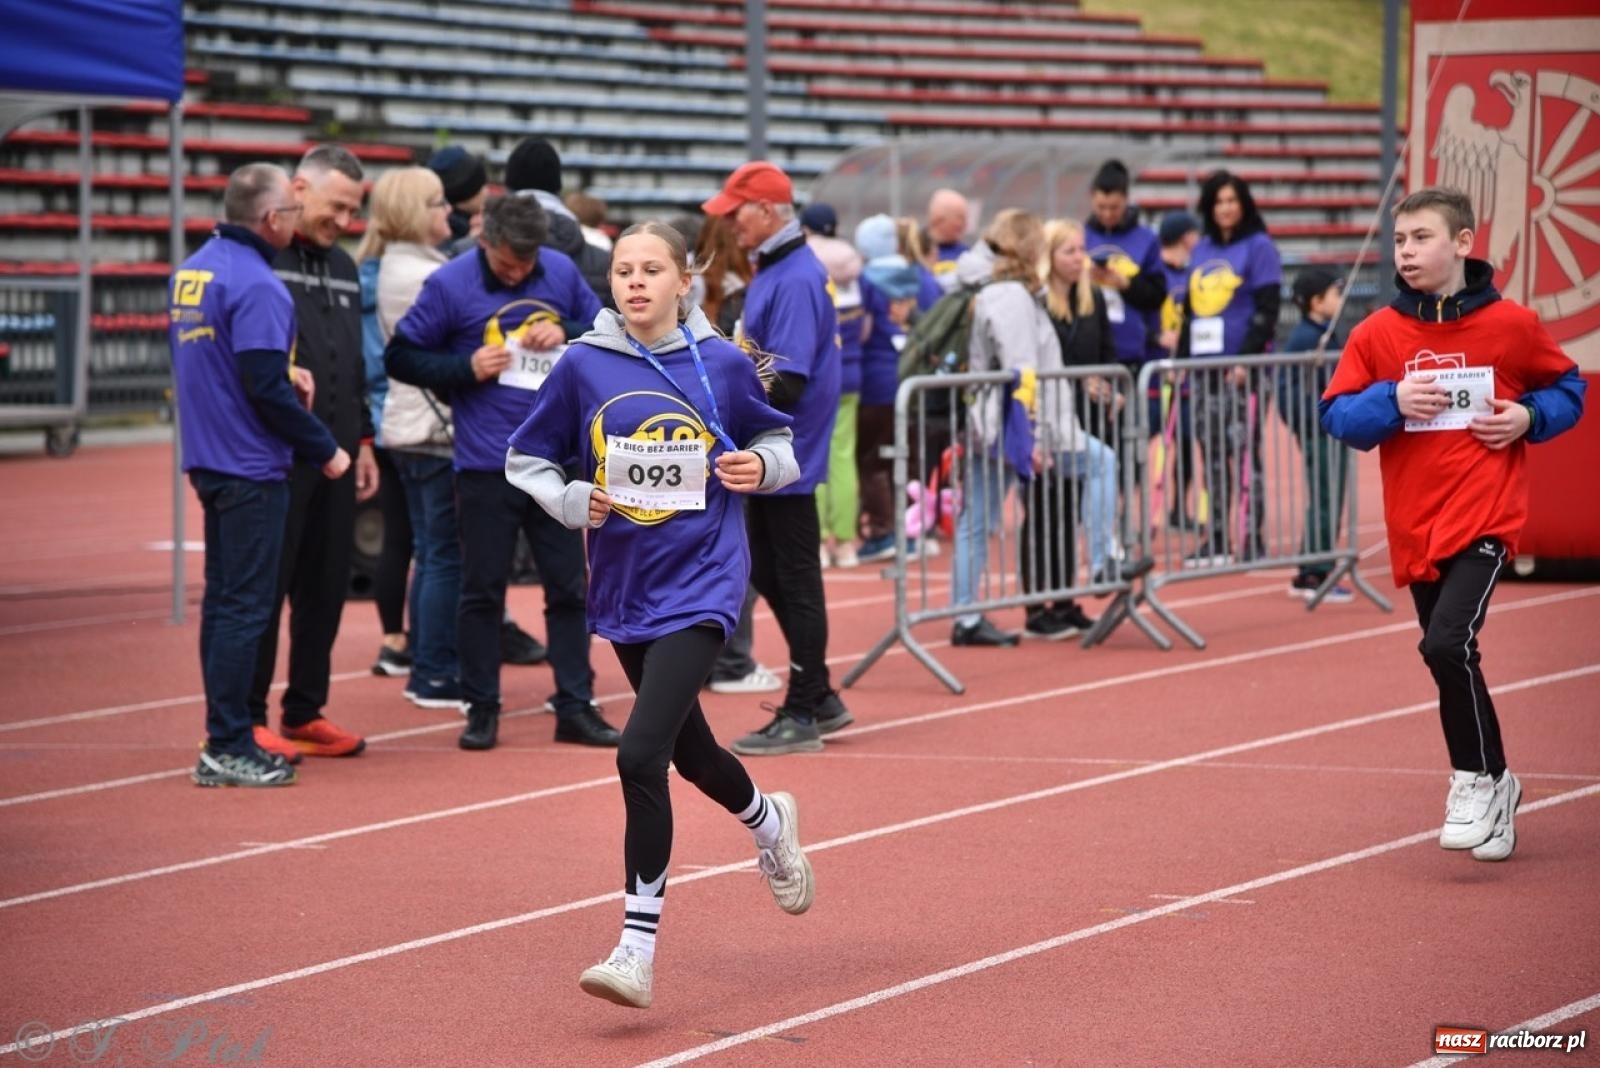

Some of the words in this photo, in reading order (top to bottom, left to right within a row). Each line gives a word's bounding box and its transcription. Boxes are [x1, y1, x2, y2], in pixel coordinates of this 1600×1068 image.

[520, 356, 552, 374] 130
[623, 442, 645, 453] BIEG
[647, 444, 665, 453] BEZ
[628, 463, 682, 487] 093
